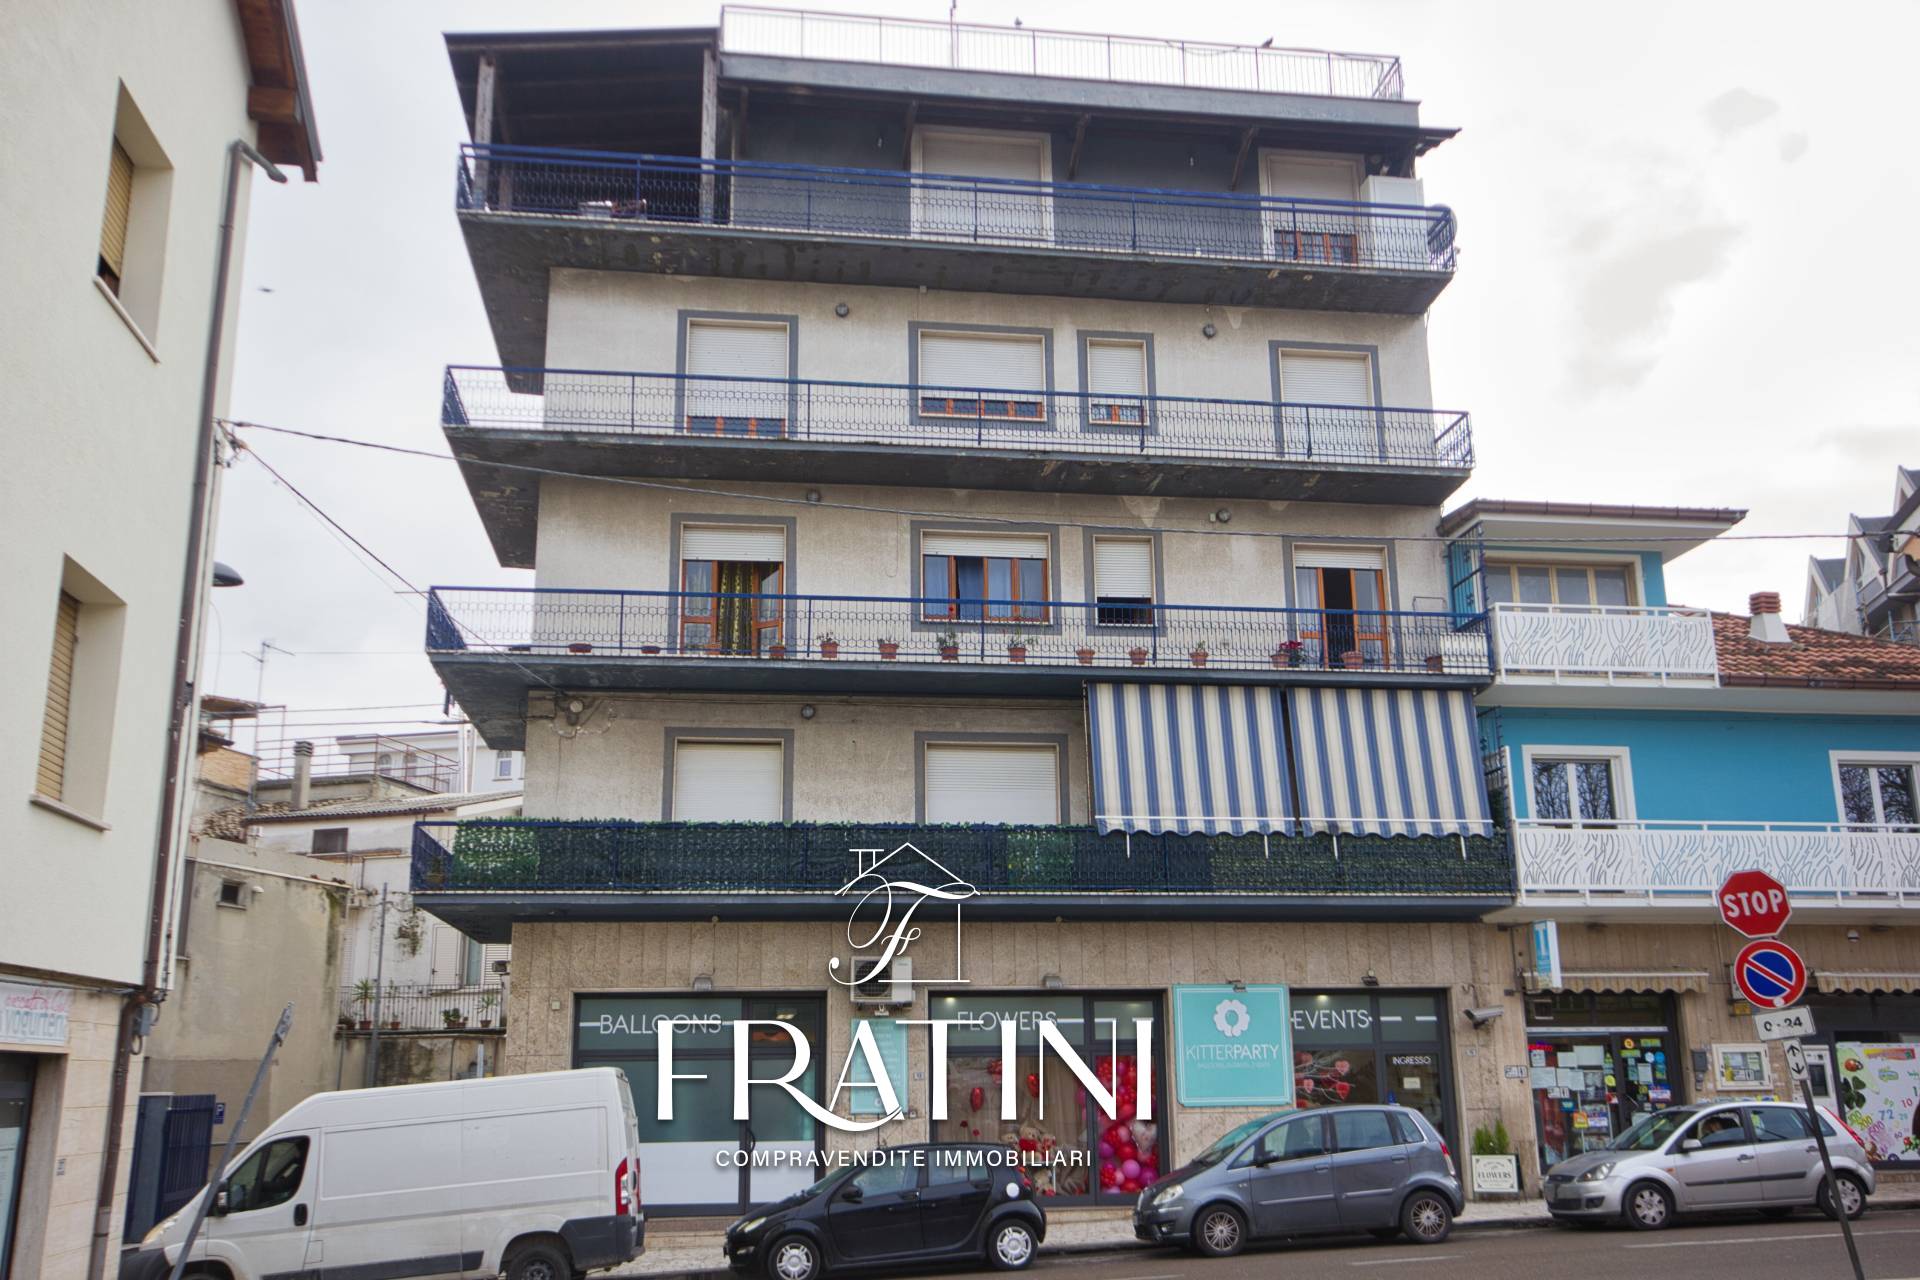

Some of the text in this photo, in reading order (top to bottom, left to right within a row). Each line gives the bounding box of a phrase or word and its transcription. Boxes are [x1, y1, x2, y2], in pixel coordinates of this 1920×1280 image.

[1723, 888, 1784, 918] STOP
[600, 1014, 722, 1035] BALLOONS
[1293, 1009, 1370, 1030] EVENTS
[1185, 1044, 1280, 1060] KITTERPARTY
[1392, 1056, 1432, 1066] INGRESSO
[1878, 1109, 1894, 1121] 72
